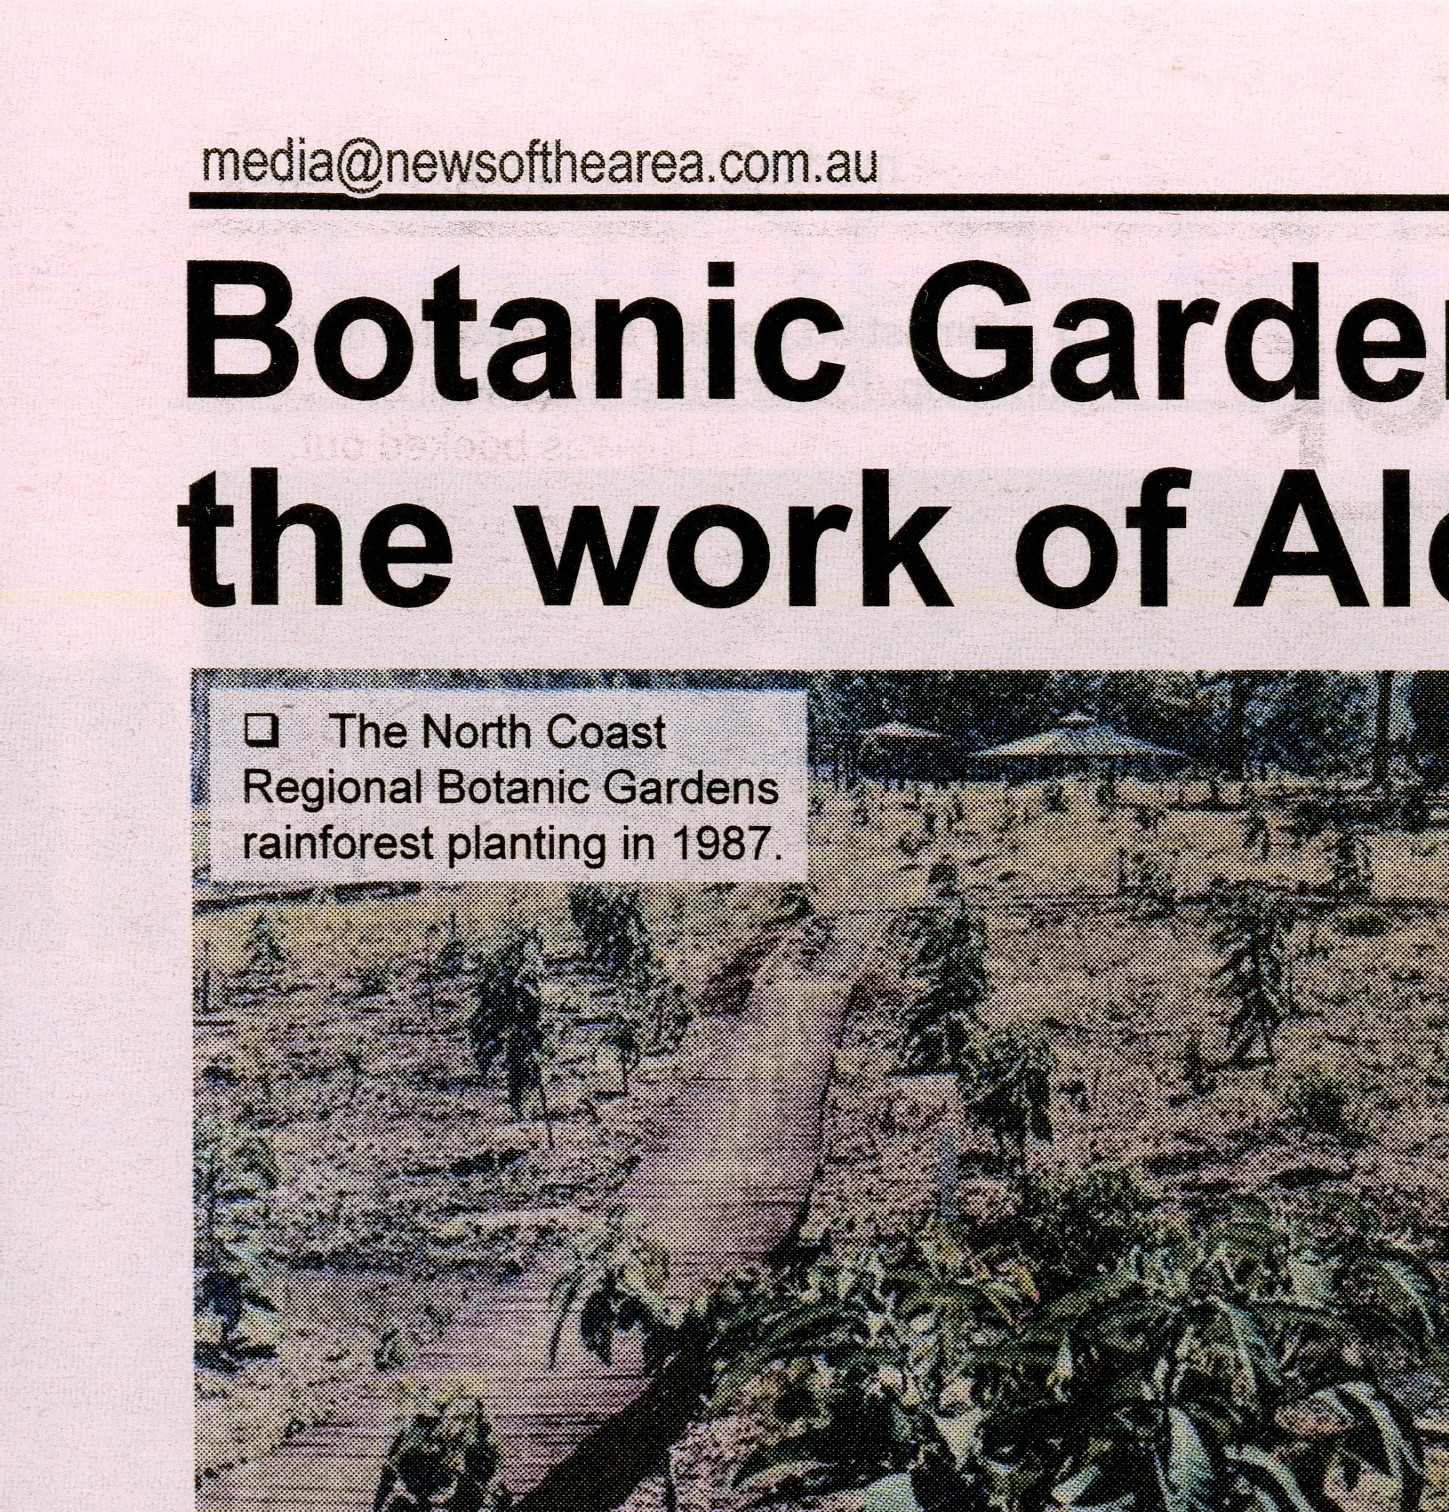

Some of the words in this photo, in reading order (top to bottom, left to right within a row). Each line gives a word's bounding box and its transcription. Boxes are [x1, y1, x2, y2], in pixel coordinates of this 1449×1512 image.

[201, 138, 879, 194] media@newsofthearea.com.au
[186, 259, 846, 403] Botanic
[176, 466, 453, 609] the
[513, 468, 955, 610] work
[1014, 466, 1193, 610] of
[328, 712, 408, 749] The
[422, 713, 532, 749] North
[546, 712, 667, 750] Coast
[243, 767, 423, 814] Regional
[438, 768, 590, 805] Botanic
[602, 767, 780, 806] Gardens
[243, 823, 434, 860] rainforest
[448, 824, 606, 870] planting
[622, 833, 655, 861] in
[673, 824, 782, 861] 1987.
